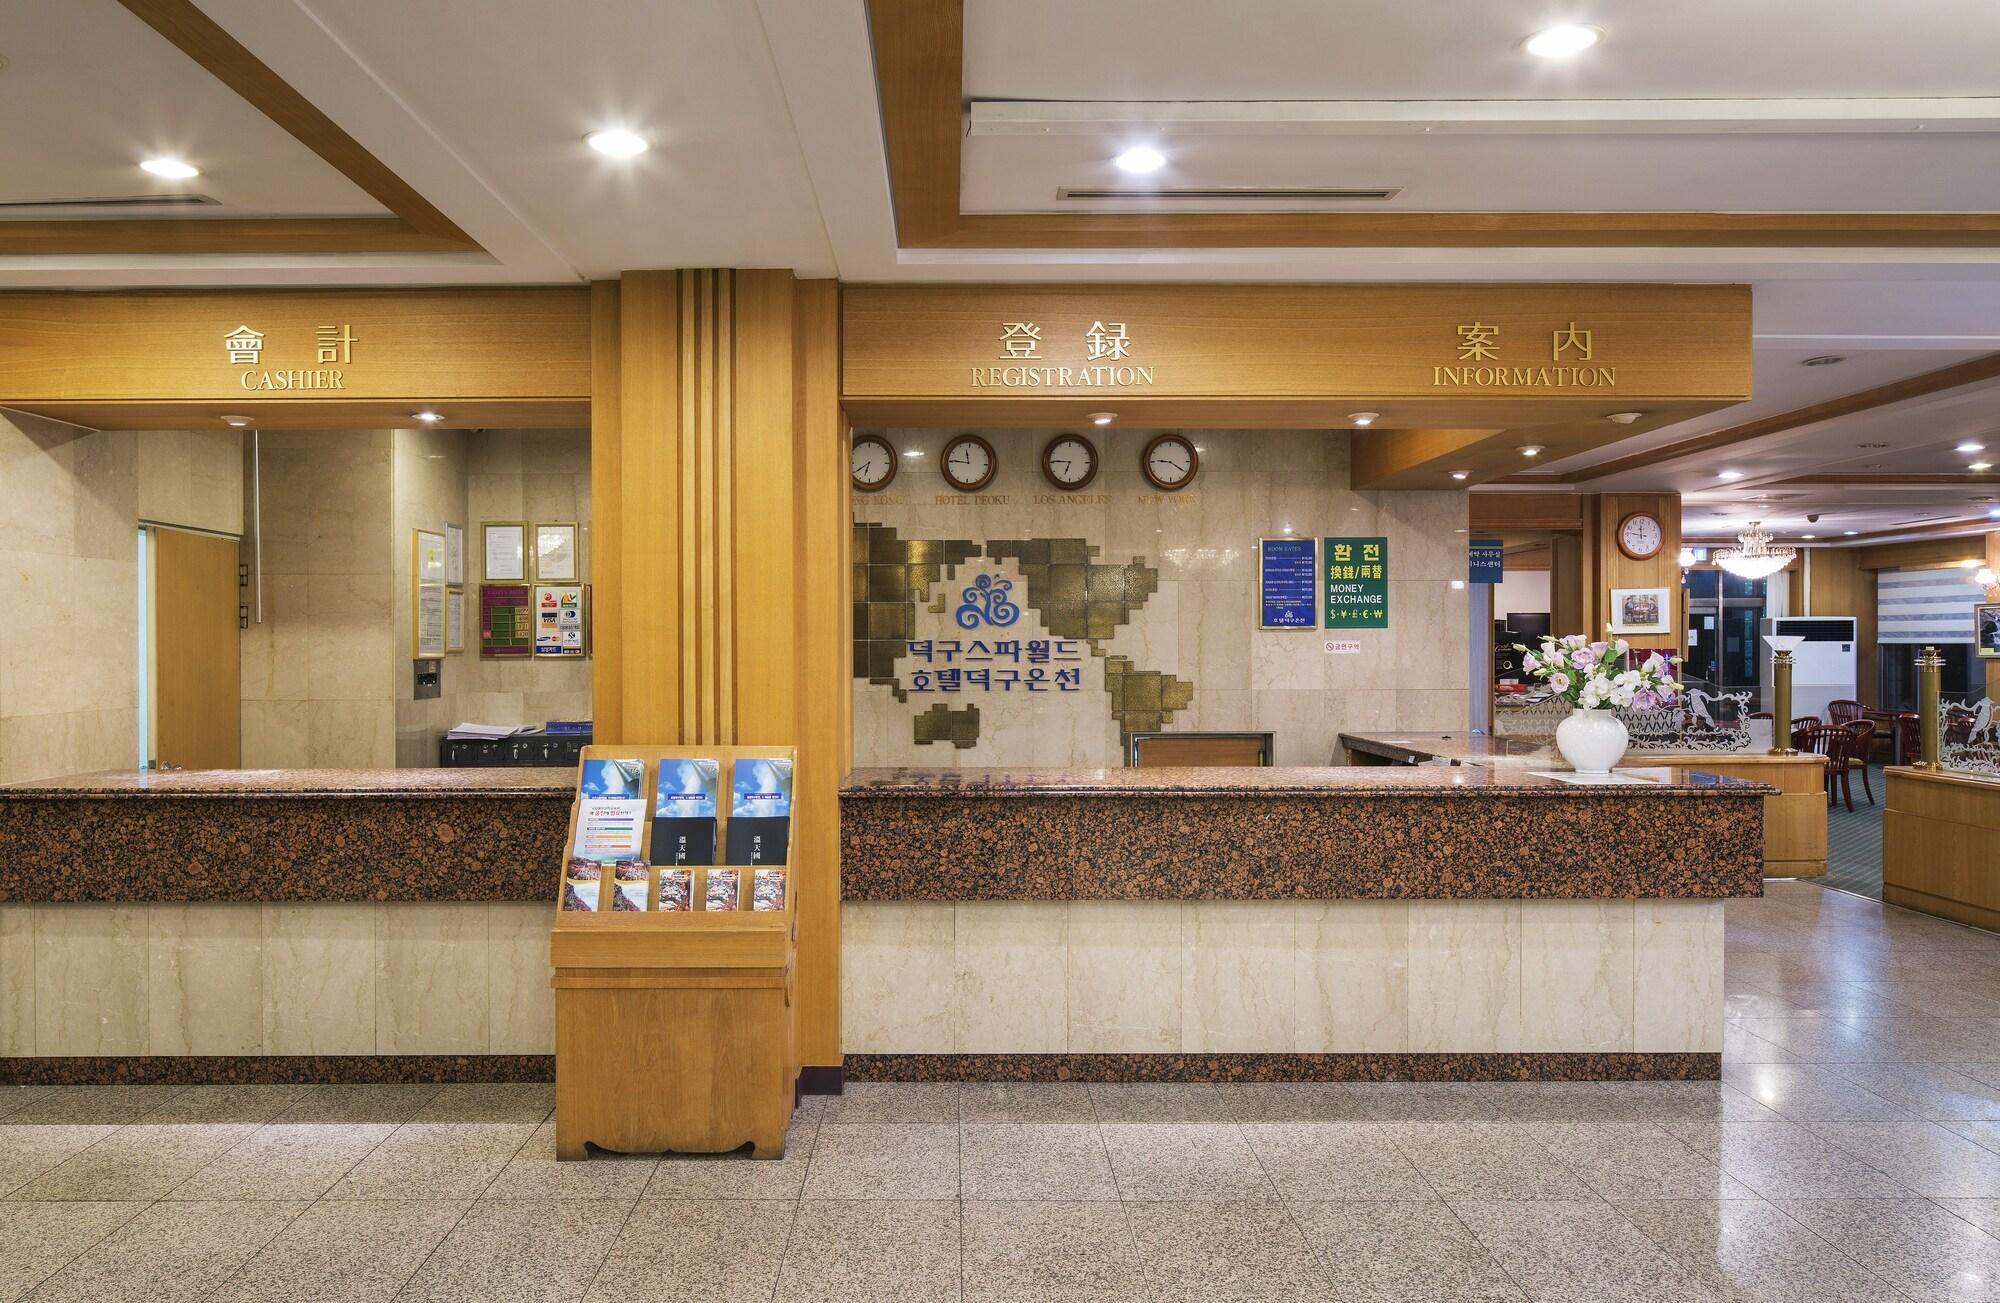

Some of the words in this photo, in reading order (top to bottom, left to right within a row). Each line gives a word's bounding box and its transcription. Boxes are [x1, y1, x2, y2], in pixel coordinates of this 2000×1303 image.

[223, 324, 359, 365] 會計
[240, 369, 345, 391] CASHIER
[971, 366, 1155, 387] REGISTRATION
[1432, 366, 1616, 387] INFORMATION
[935, 495, 970, 505] HOTEL
[1033, 495, 1056, 505] LOS
[1058, 495, 1112, 505] ANGELES
[1138, 495, 1164, 505] NEW
[1167, 495, 1200, 505] YORK
[1330, 584, 1364, 593] MONEY
[1330, 595, 1382, 604] EXCHANGE
[906, 639, 1082, 664] 덕구스파월드
[908, 668, 1081, 692] 호텔덕구온천
